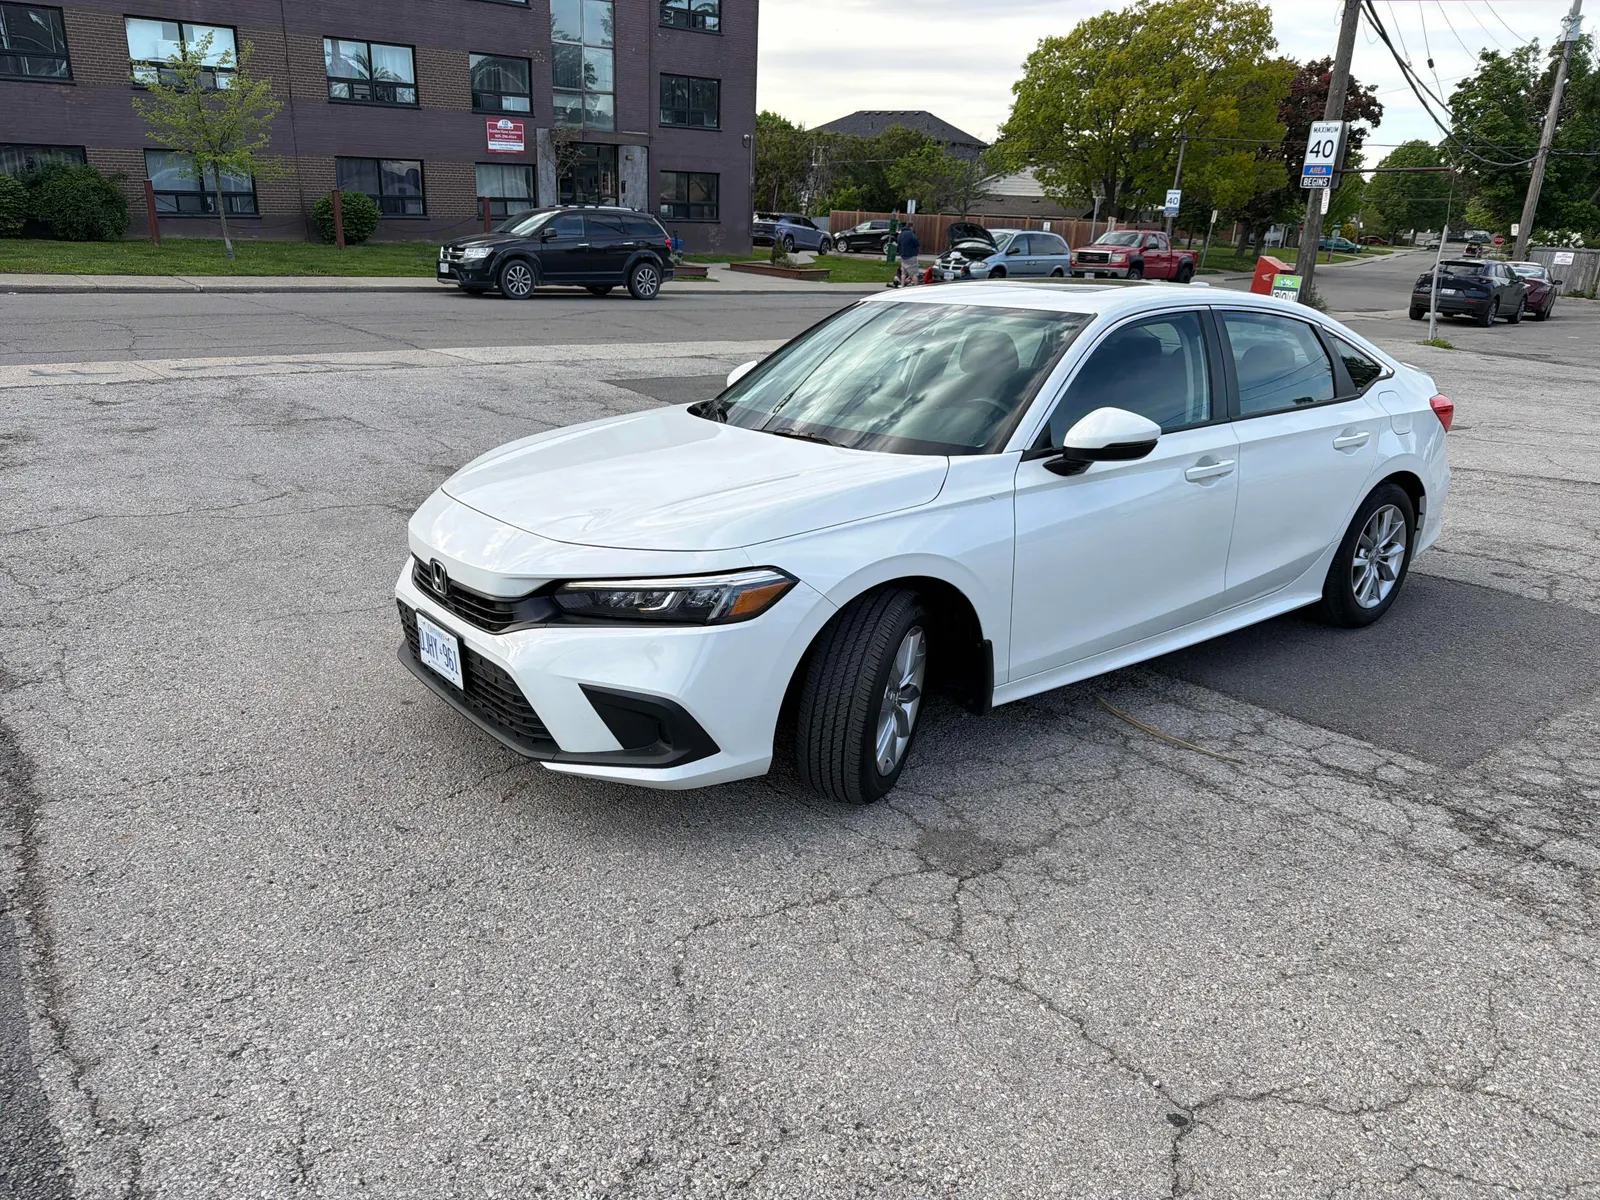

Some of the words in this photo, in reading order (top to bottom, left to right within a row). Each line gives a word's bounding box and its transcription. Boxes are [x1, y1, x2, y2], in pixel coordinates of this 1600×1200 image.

[1309, 139, 1335, 158] 40
[1303, 178, 1328, 187] BEGINS
[1167, 196, 1179, 205] 40
[442, 643, 460, 675] 961
